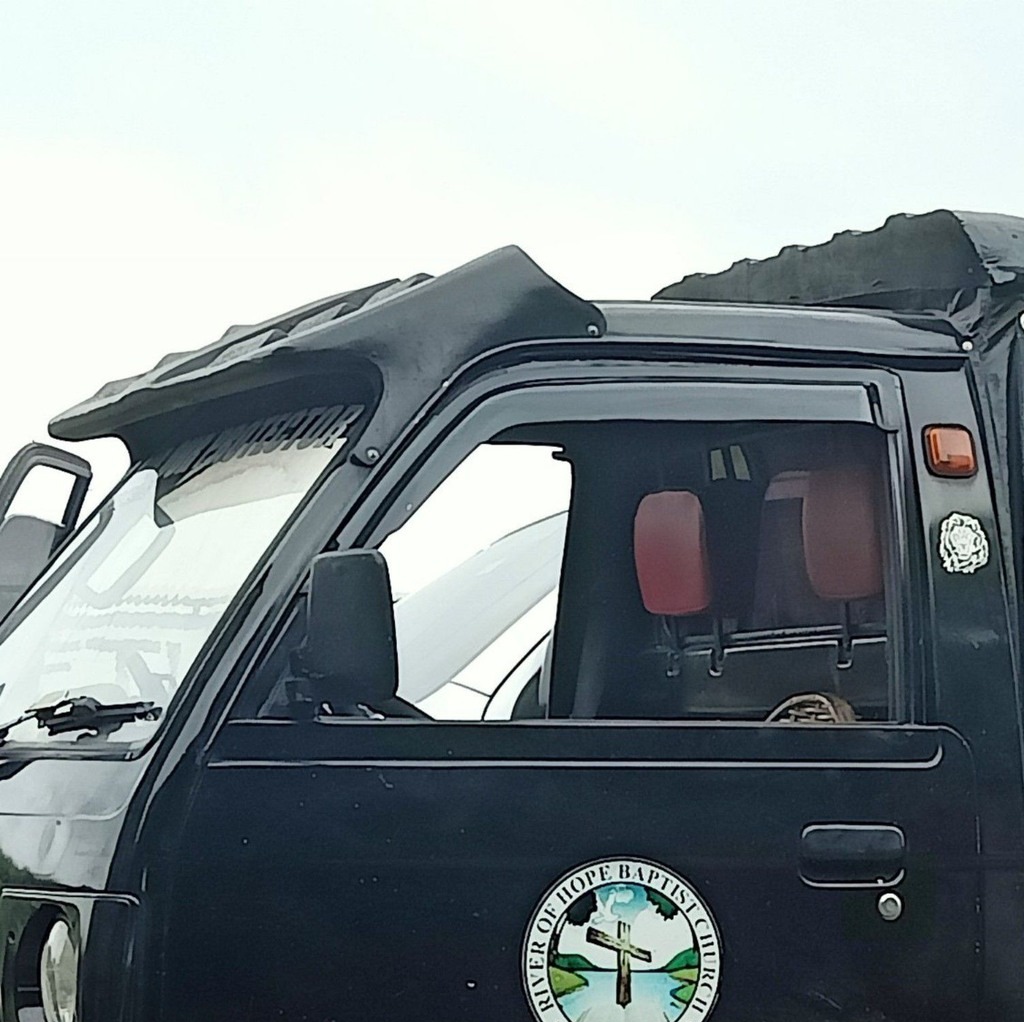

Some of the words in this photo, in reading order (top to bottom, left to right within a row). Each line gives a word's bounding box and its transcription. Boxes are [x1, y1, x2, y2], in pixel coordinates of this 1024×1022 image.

[558, 864, 613, 905] HOPE
[619, 864, 700, 915] BAPTIST
[536, 903, 557, 934] OF
[529, 941, 555, 1012] RIVER
[691, 918, 717, 1014] CHURCH
